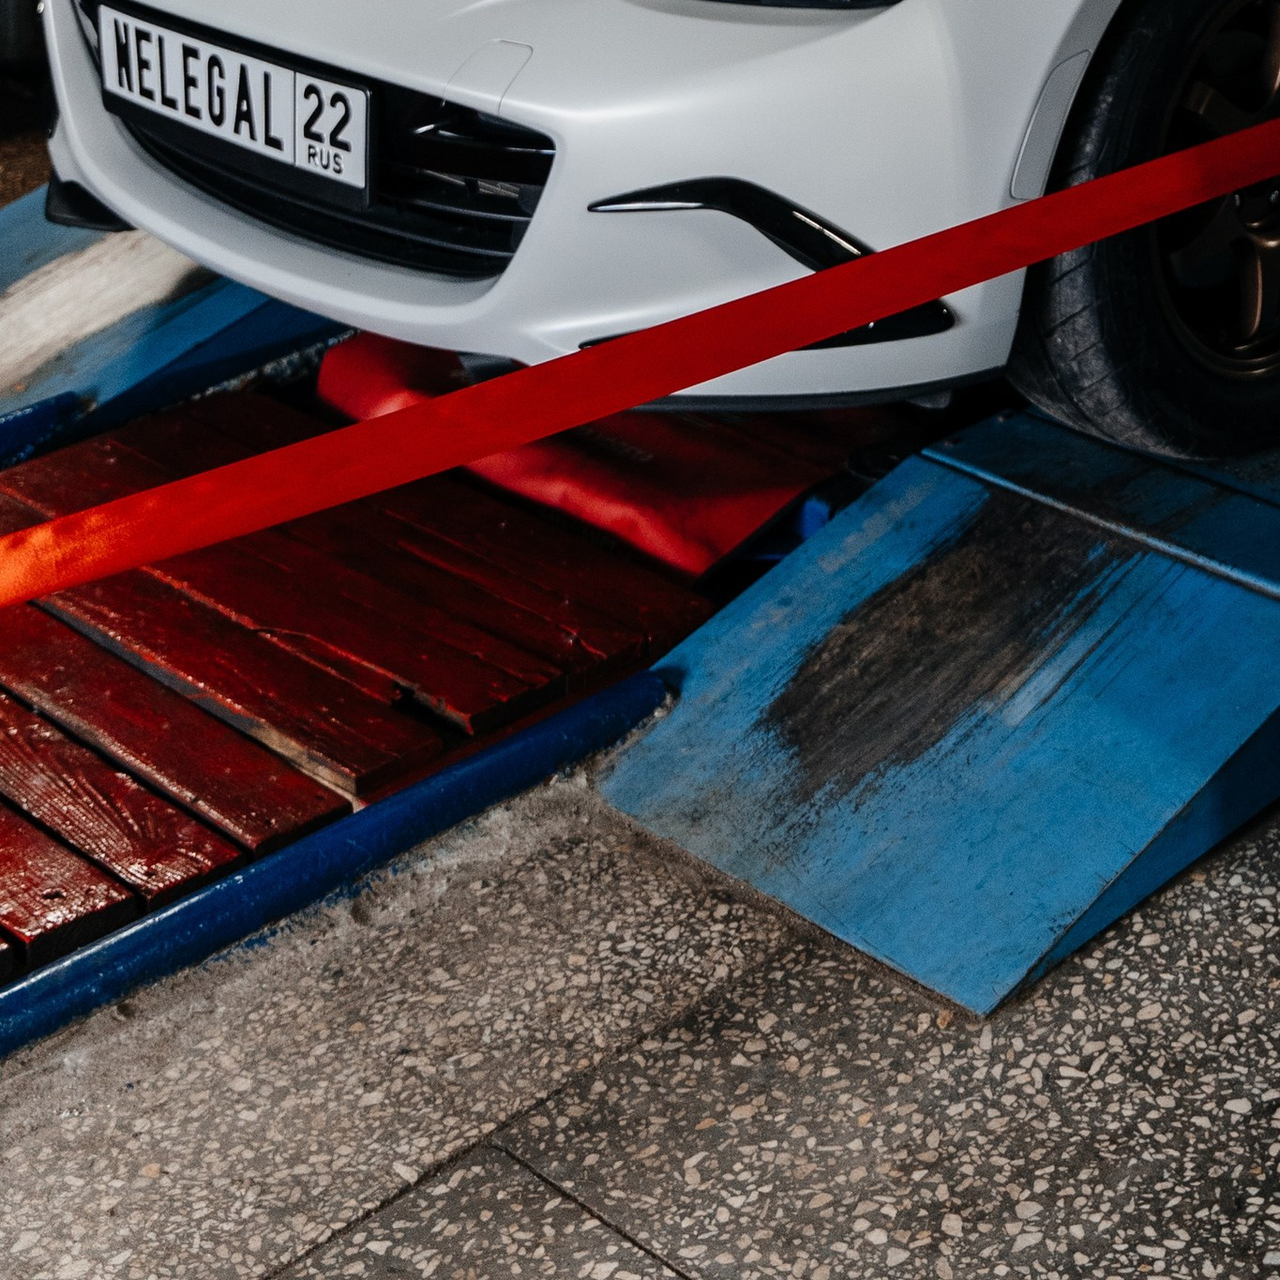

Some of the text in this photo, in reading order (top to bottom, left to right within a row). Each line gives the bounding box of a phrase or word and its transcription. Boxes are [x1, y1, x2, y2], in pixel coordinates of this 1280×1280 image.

[113, 17, 352, 153] NELEGAL 22
[307, 144, 344, 175] RUS
